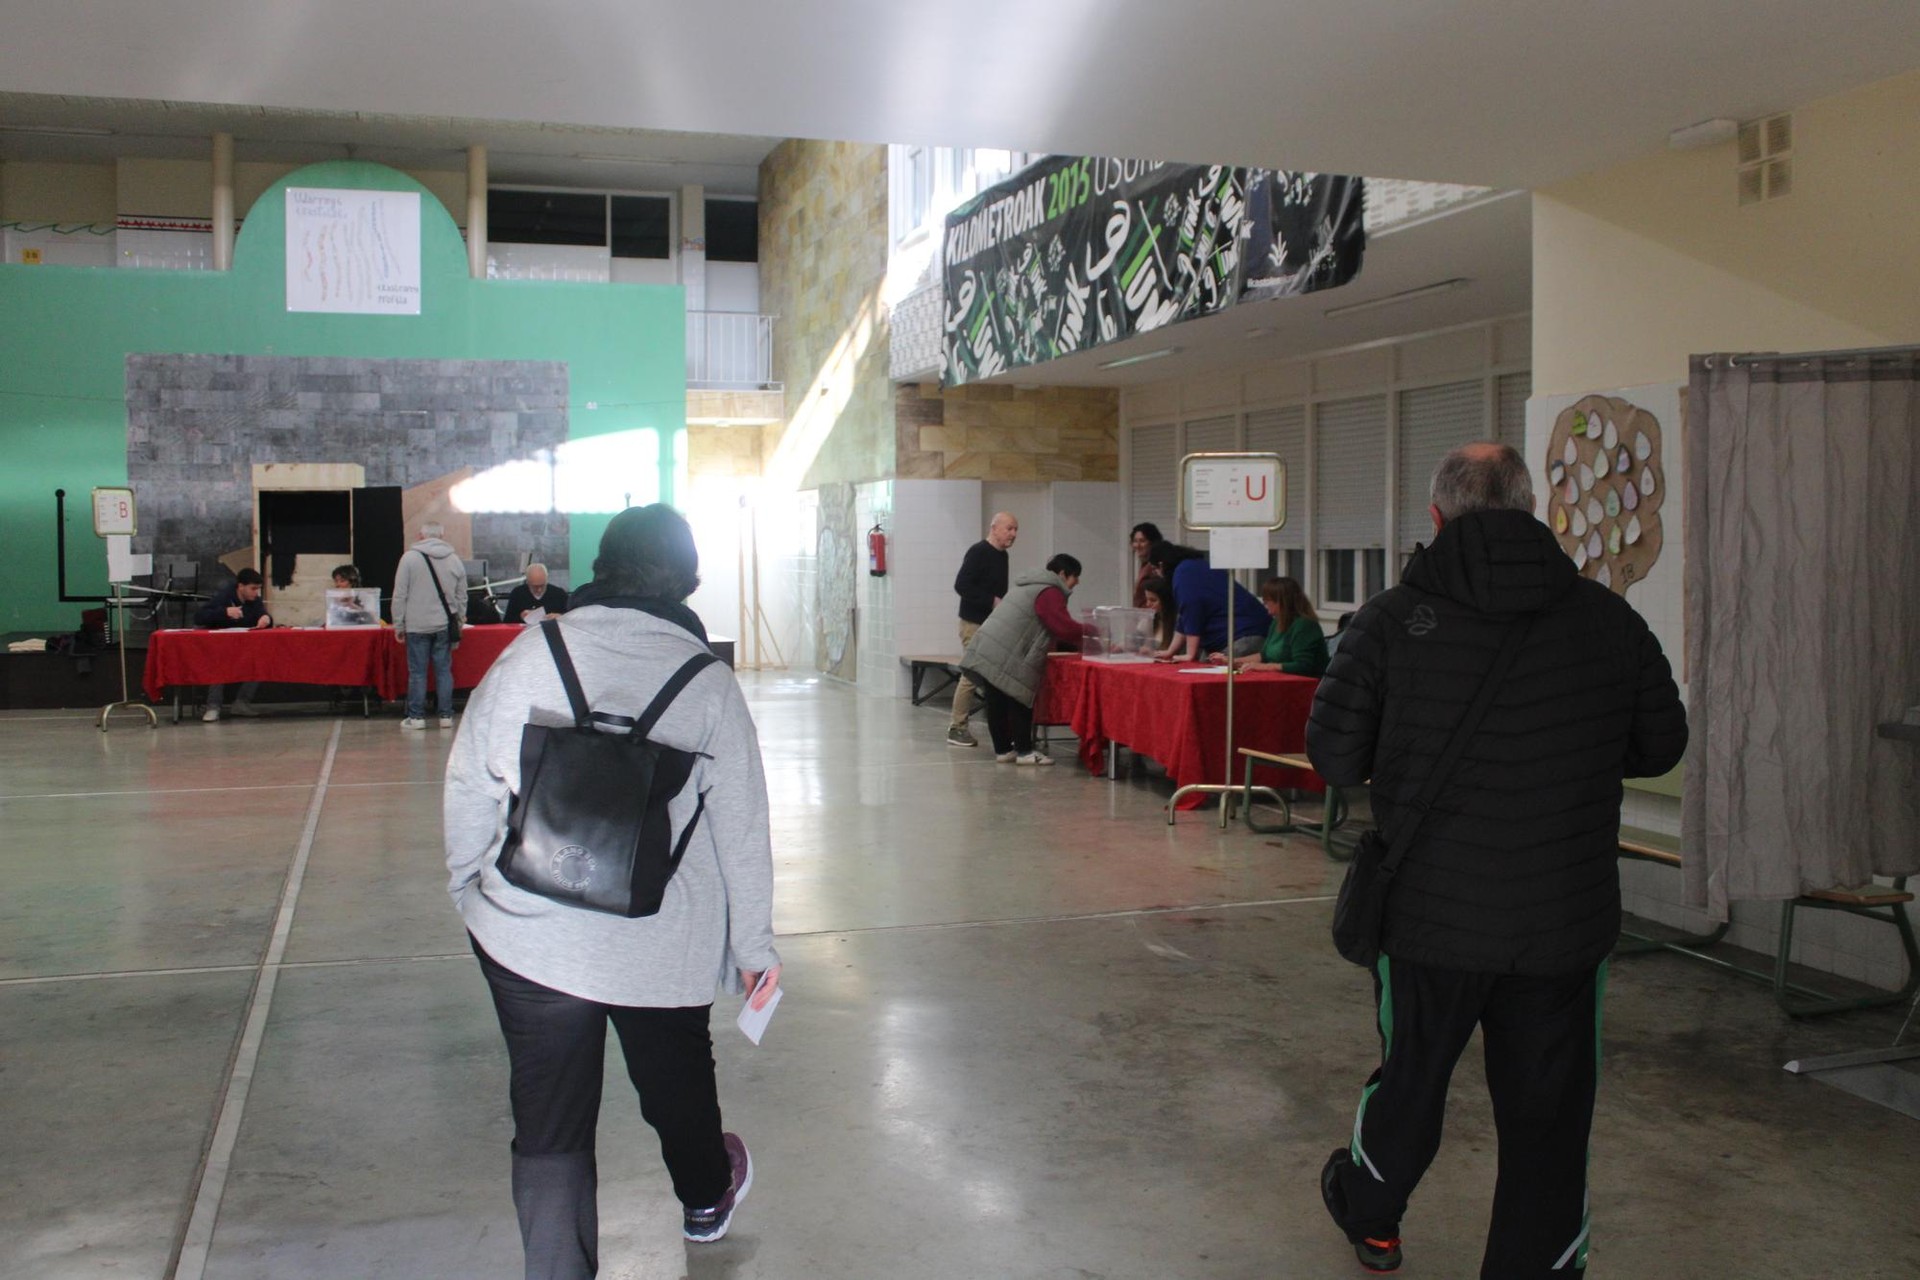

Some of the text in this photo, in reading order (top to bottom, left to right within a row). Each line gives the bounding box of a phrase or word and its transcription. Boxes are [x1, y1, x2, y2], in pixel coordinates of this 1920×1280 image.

[945, 174, 1047, 267] KILOMETROAK
[1046, 155, 1091, 221] 2015
[1246, 475, 1266, 500] U
[119, 501, 128, 518] B
